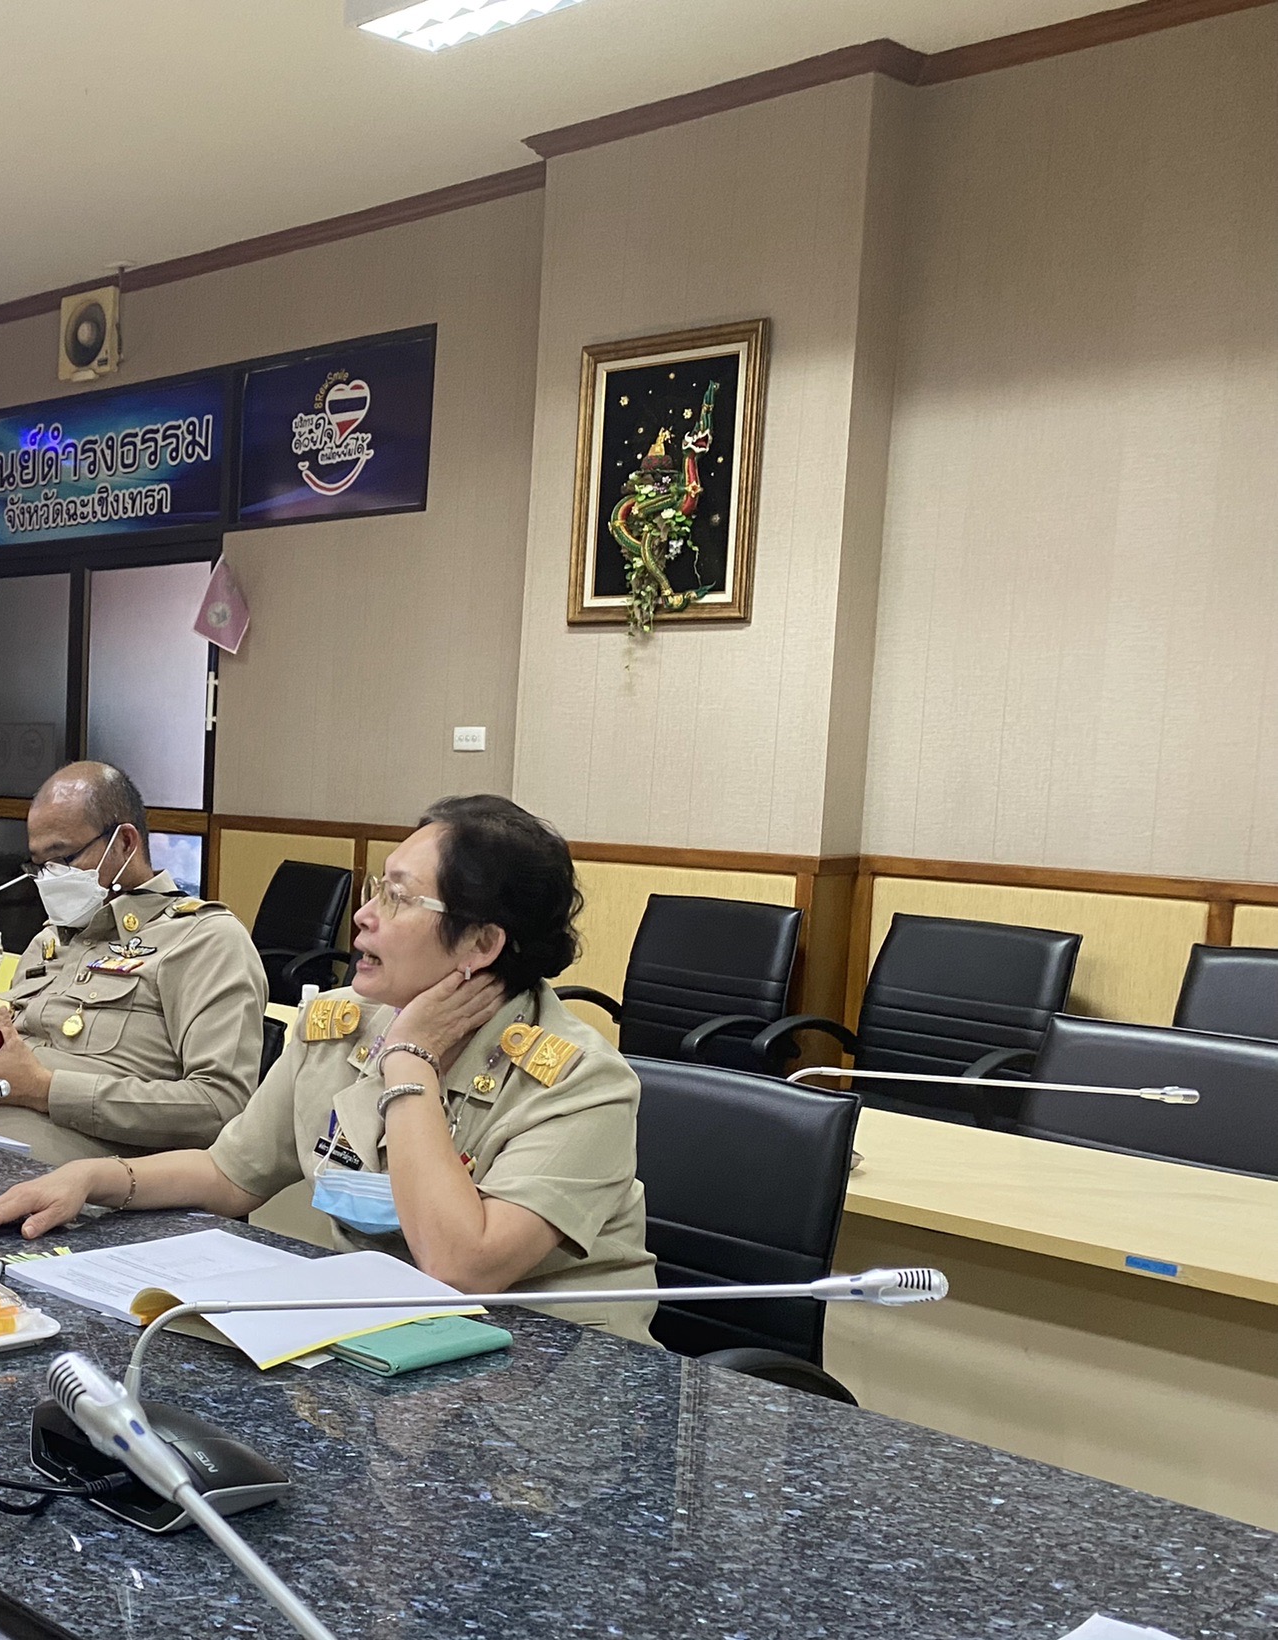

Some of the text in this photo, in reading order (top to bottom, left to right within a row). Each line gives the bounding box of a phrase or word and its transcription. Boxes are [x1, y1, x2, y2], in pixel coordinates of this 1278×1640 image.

[4, 482, 171, 533] จังหวัดฉะเชิงเทรา
